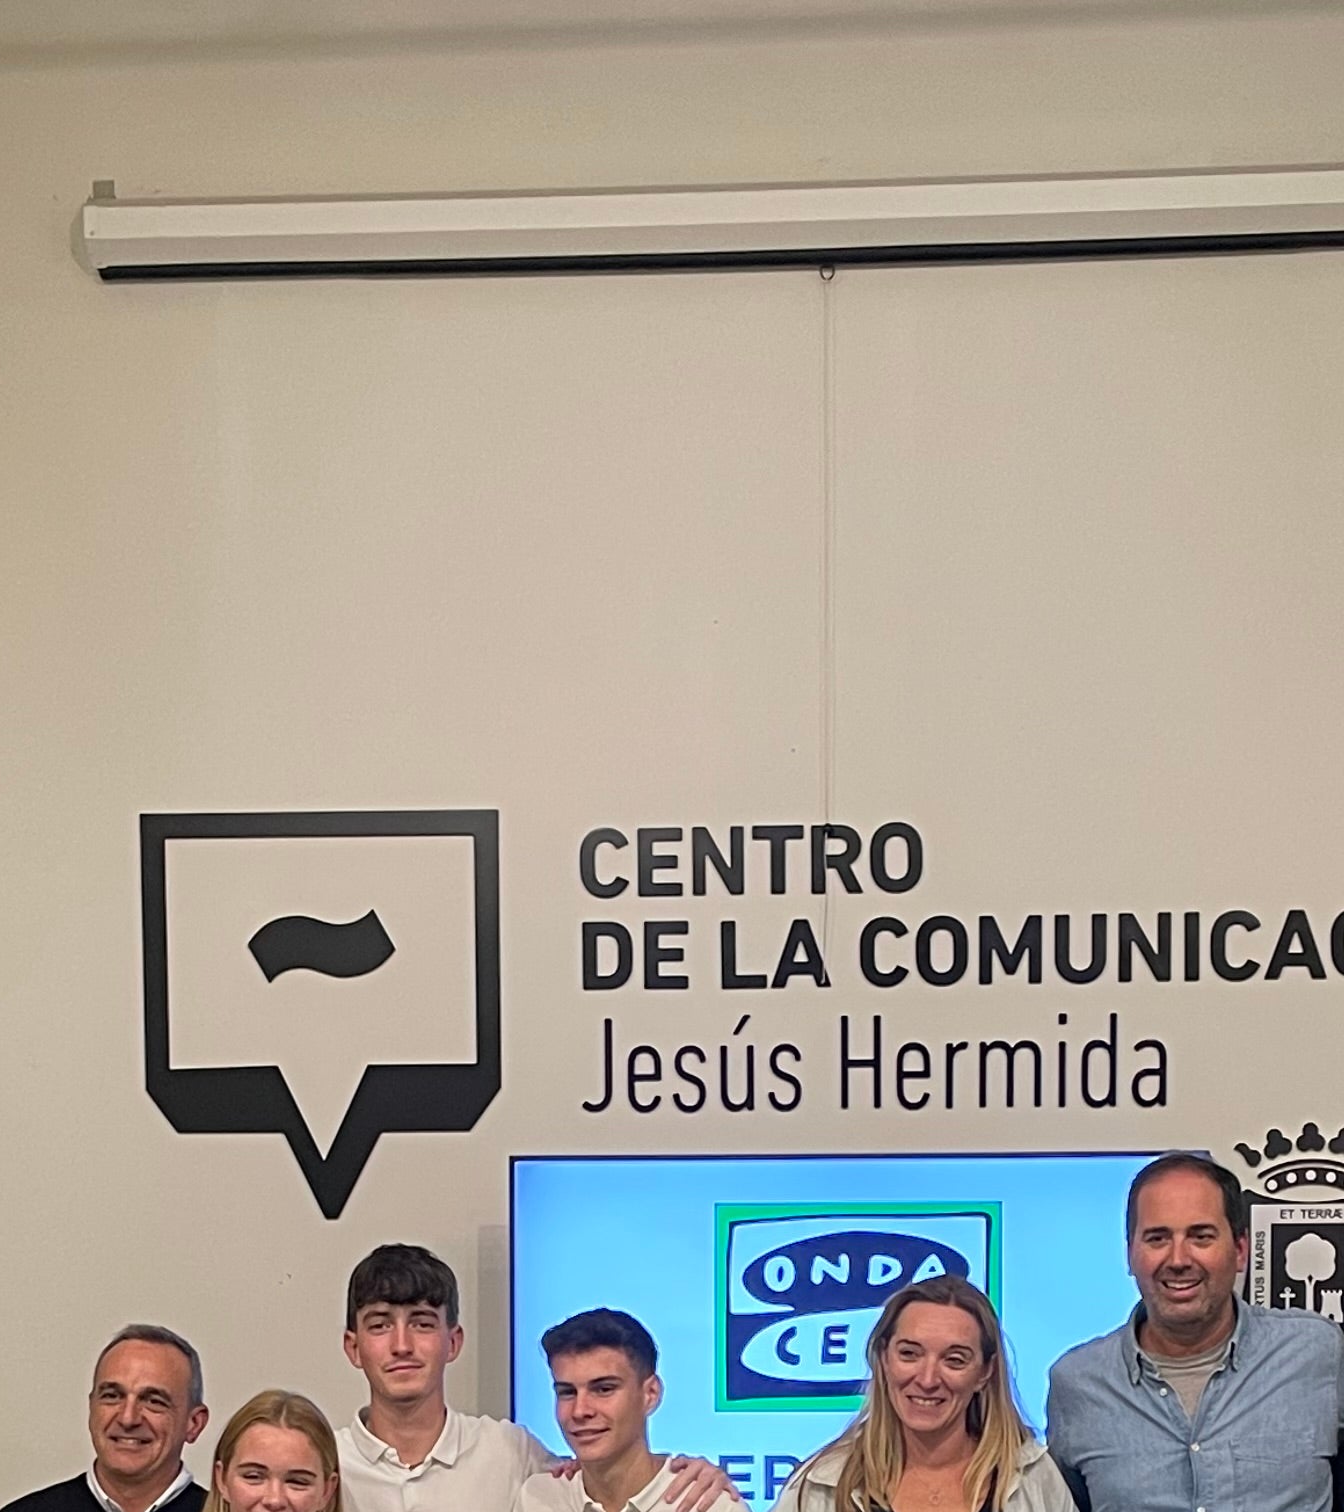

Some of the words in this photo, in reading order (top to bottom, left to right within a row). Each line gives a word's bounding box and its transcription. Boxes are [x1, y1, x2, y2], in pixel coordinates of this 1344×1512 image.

[580, 822, 923, 898] CENTRO
[582, 921, 689, 990] DE
[720, 919, 832, 989] LA
[582, 1016, 802, 1113] Jesús
[840, 1012, 1167, 1110] Hermida
[1279, 1208, 1295, 1220] ET
[762, 1252, 947, 1294] ONDA
[775, 1323, 851, 1367] CE
